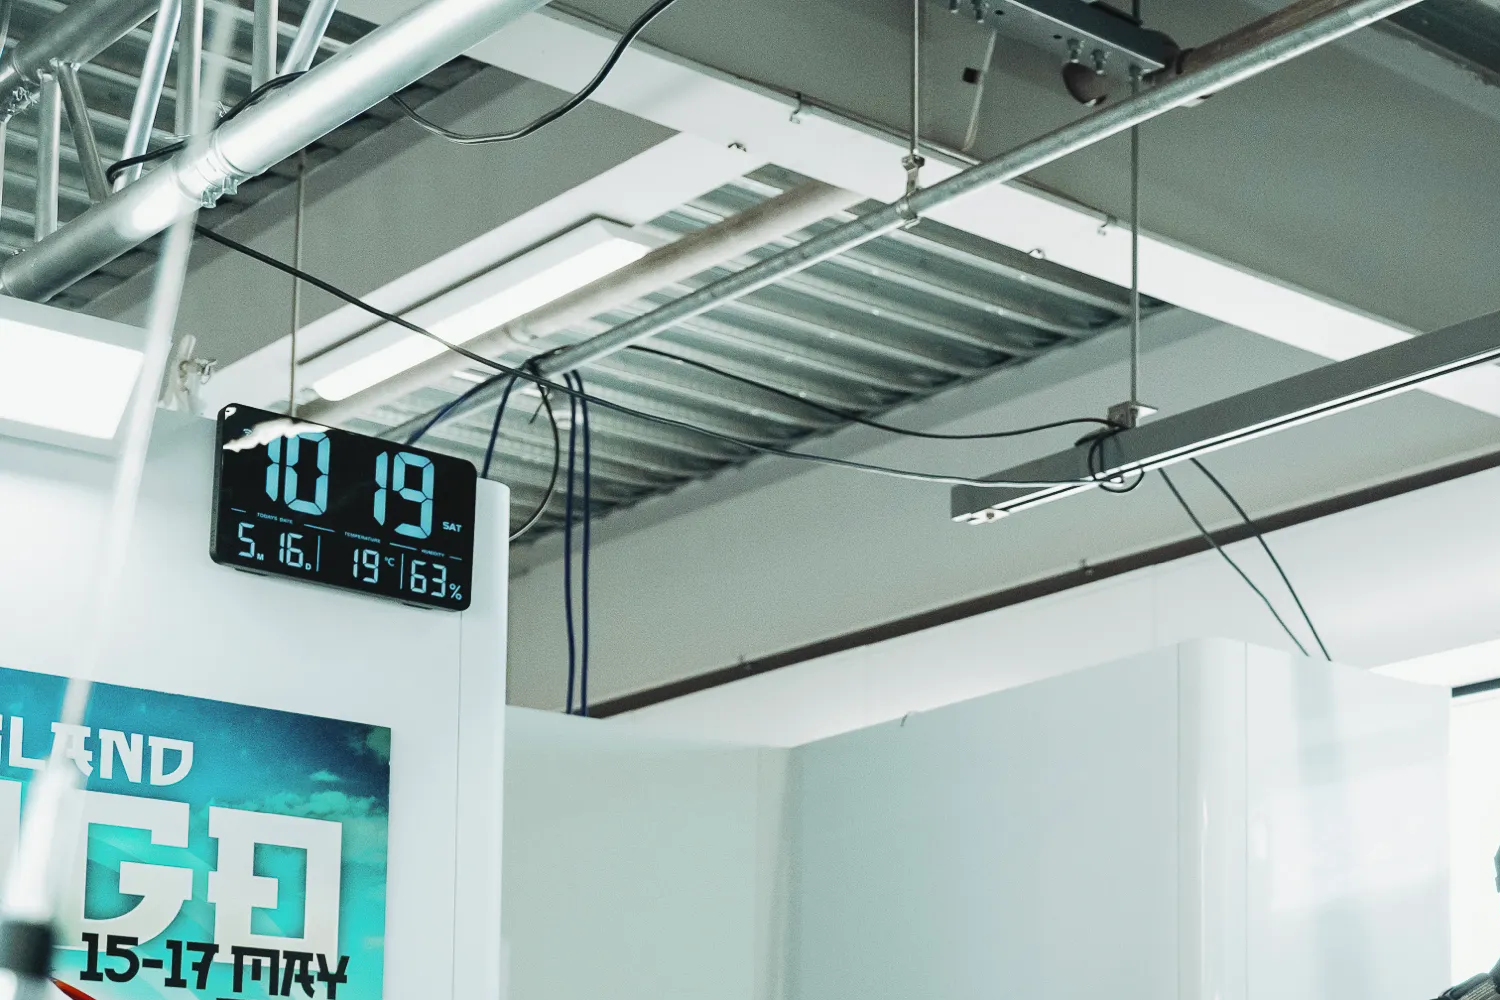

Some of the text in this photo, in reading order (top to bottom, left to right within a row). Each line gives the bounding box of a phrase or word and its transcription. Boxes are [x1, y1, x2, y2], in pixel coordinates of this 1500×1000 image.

[265, 431, 435, 539] 10 19
[344, 531, 381, 543] TEMPERATURE
[442, 521, 462, 533] SAT
[0, 778, 343, 967] GO
[80, 931, 350, 1000] 15-17 MAY
